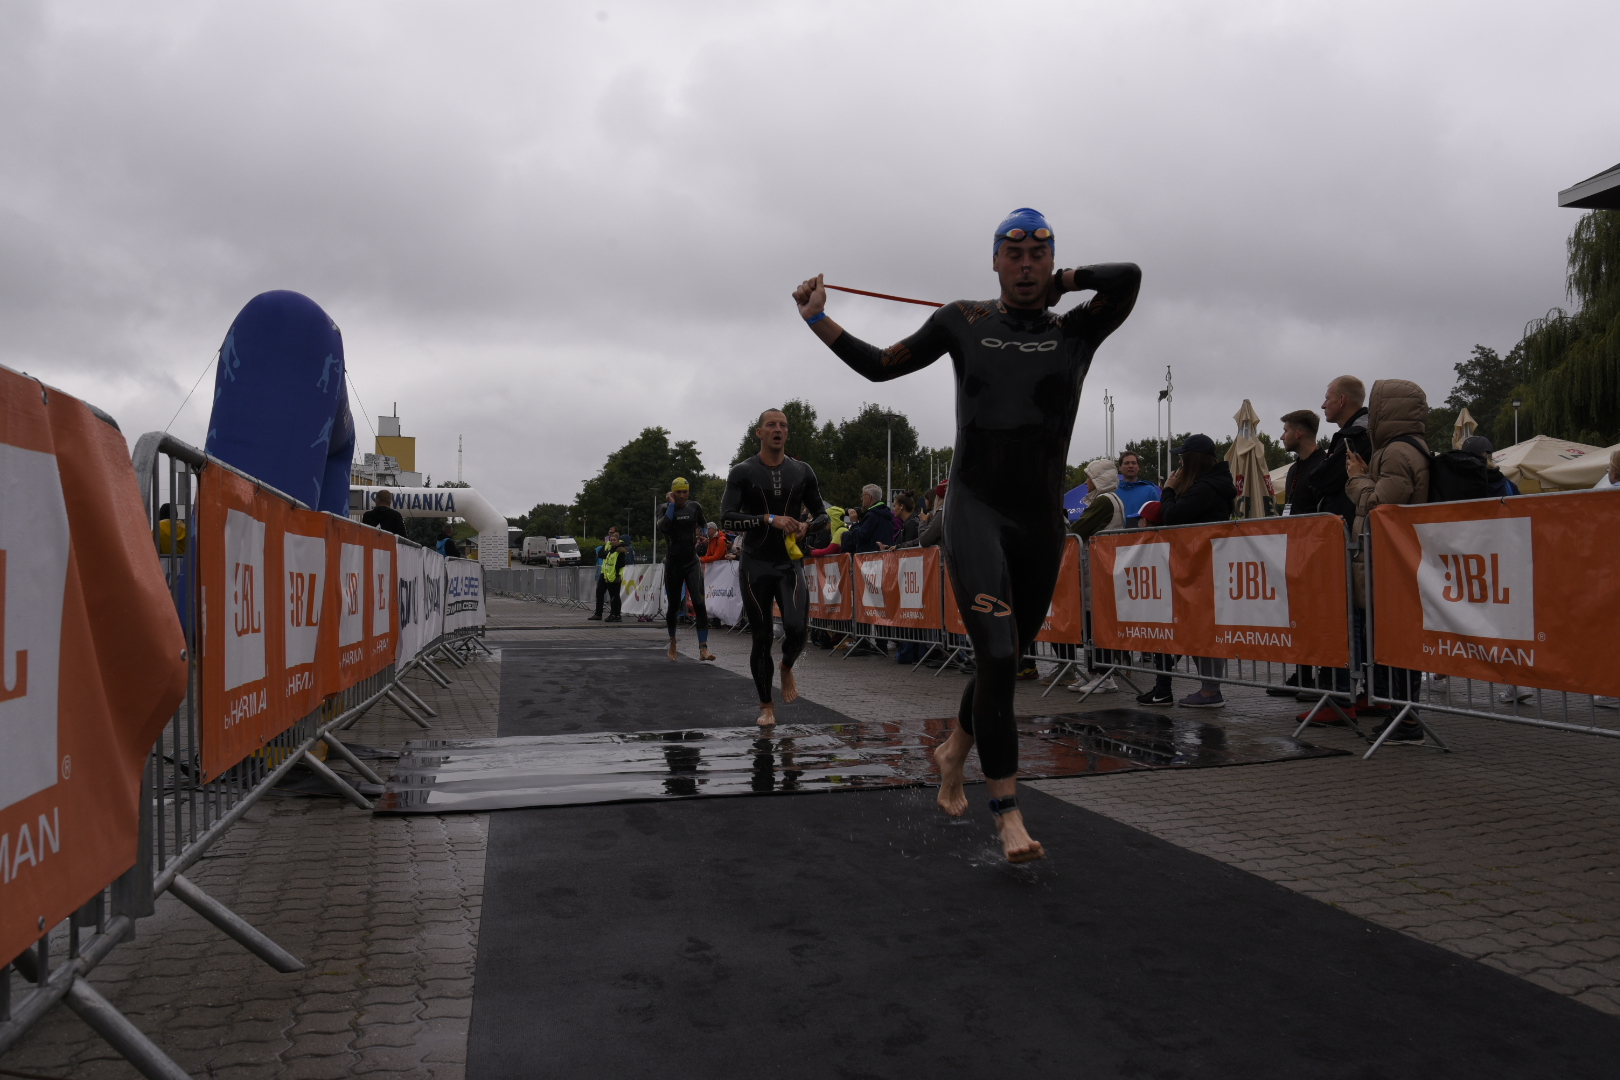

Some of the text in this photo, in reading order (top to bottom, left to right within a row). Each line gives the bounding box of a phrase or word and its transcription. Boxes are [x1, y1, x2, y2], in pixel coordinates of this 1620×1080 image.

[981, 337, 1058, 352] orca
[771, 471, 781, 496] HUUB
[904, 571, 919, 594] JBL
[1124, 566, 1161, 600] JBL
[1228, 561, 1275, 600] JBL
[1437, 553, 1509, 604] JBL
[1126, 627, 1174, 640] HARMAN
[1216, 631, 1292, 647] by HARMAN
[1423, 639, 1534, 667] by HARMAN
